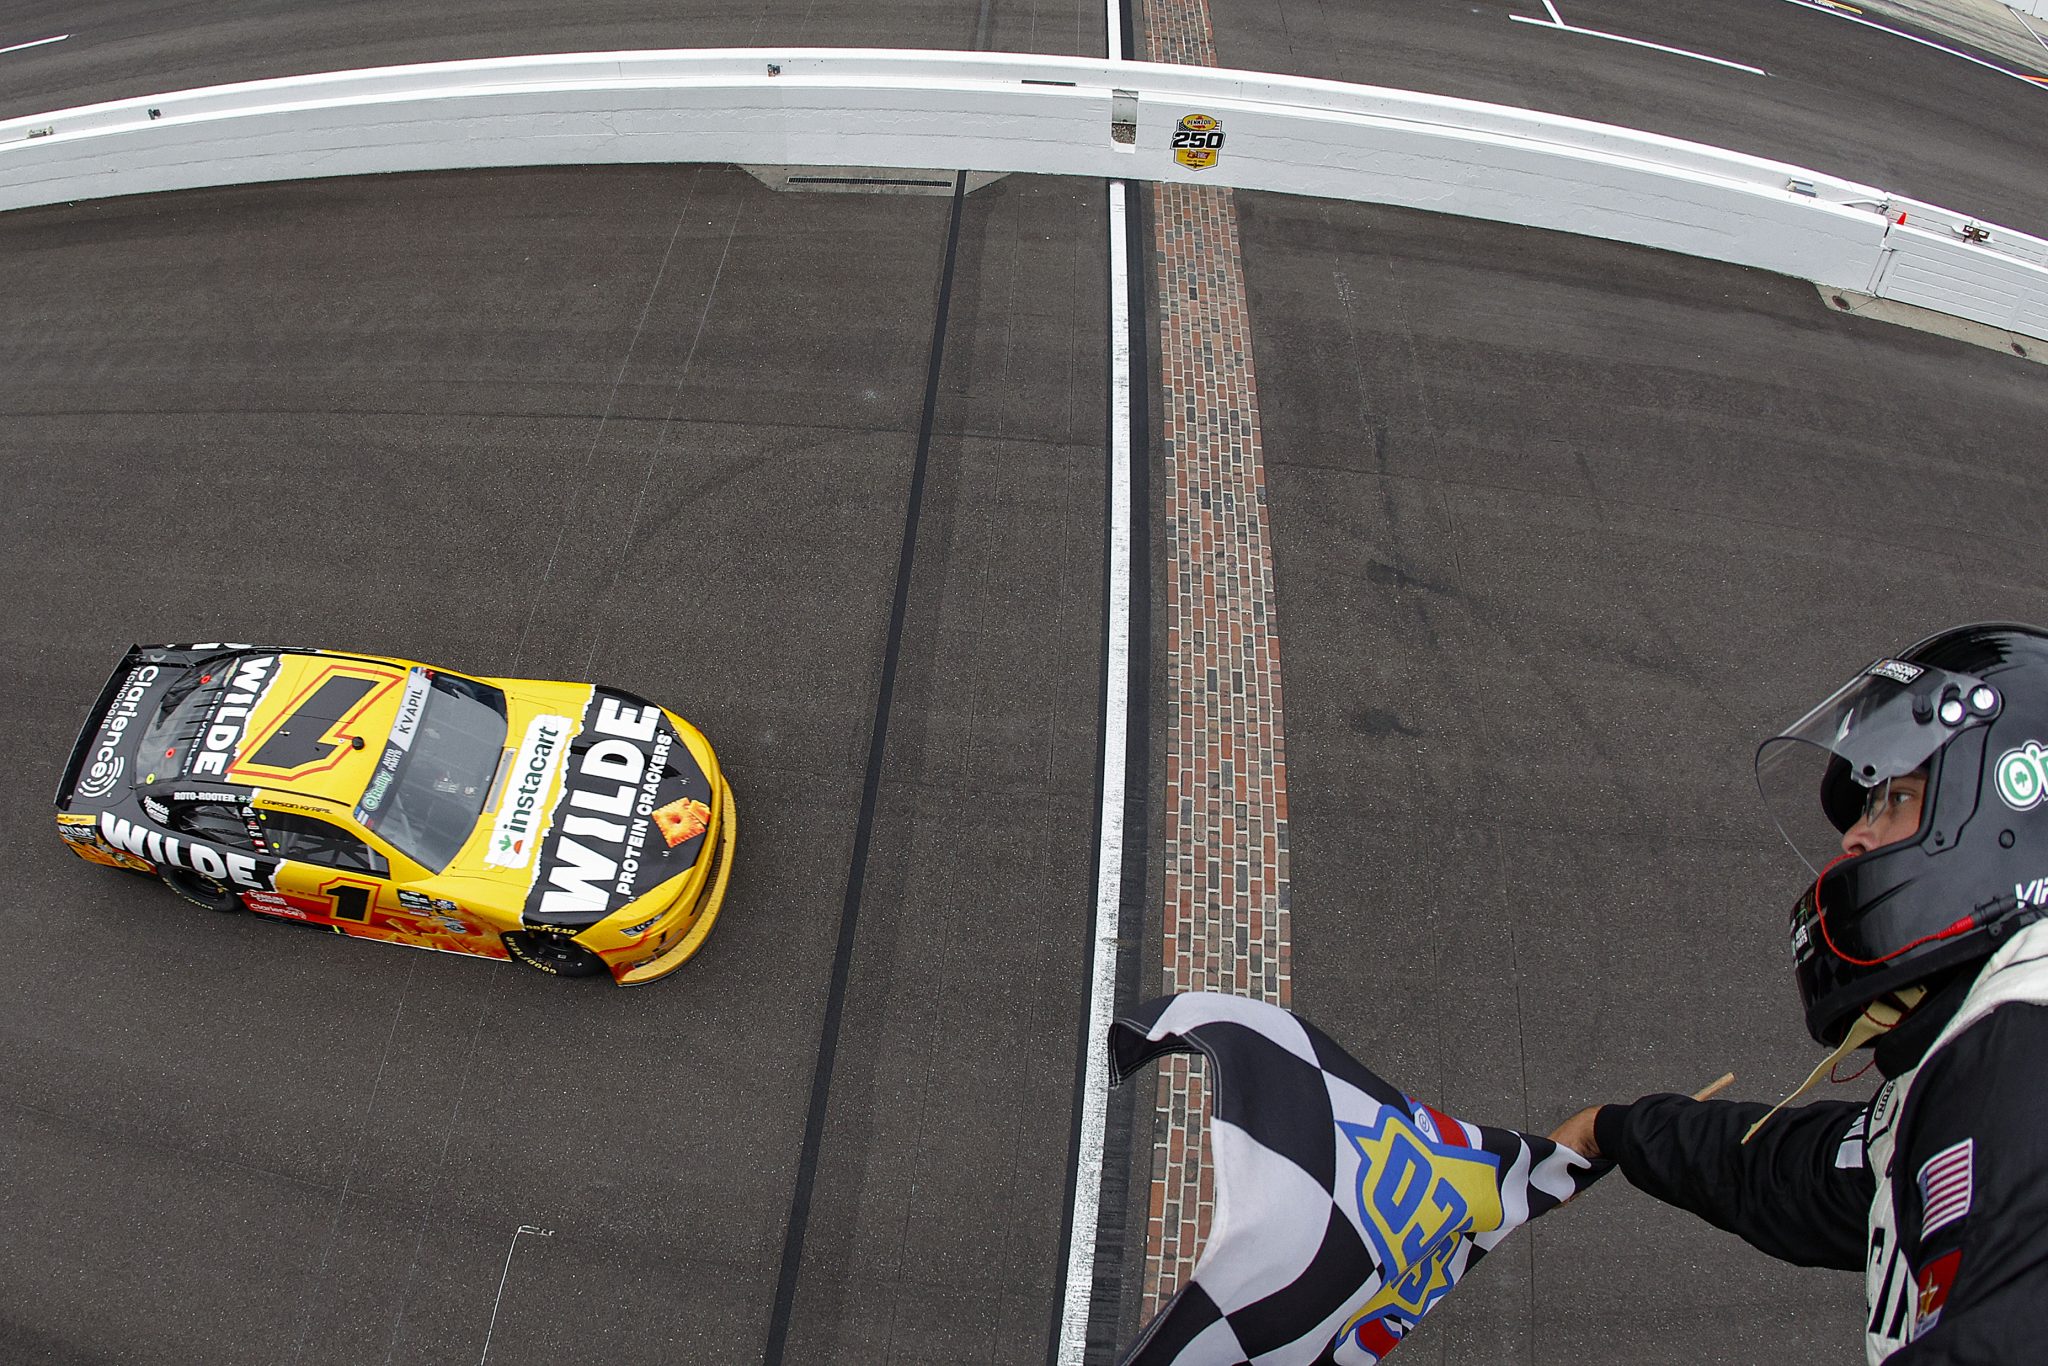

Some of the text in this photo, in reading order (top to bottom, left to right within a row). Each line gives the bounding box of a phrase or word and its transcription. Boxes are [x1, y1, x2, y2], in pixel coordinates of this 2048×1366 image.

[1172, 132, 1224, 149] 250
[91, 665, 160, 778] Clarience
[101, 666, 142, 730] TECHNOLOGIES
[192, 656, 275, 776] WILDE
[244, 672, 385, 771] 1
[398, 688, 424, 734] KVAPIL
[382, 748, 396, 767] AUTO
[387, 749, 403, 772] PARTS
[503, 725, 559, 834] instacart
[174, 791, 236, 802] ROTO-ROOTER
[539, 697, 662, 913] WILDE
[615, 732, 673, 896] PROTEIN CRACKERS
[101, 811, 263, 889] WILDE
[324, 883, 373, 923] 1
